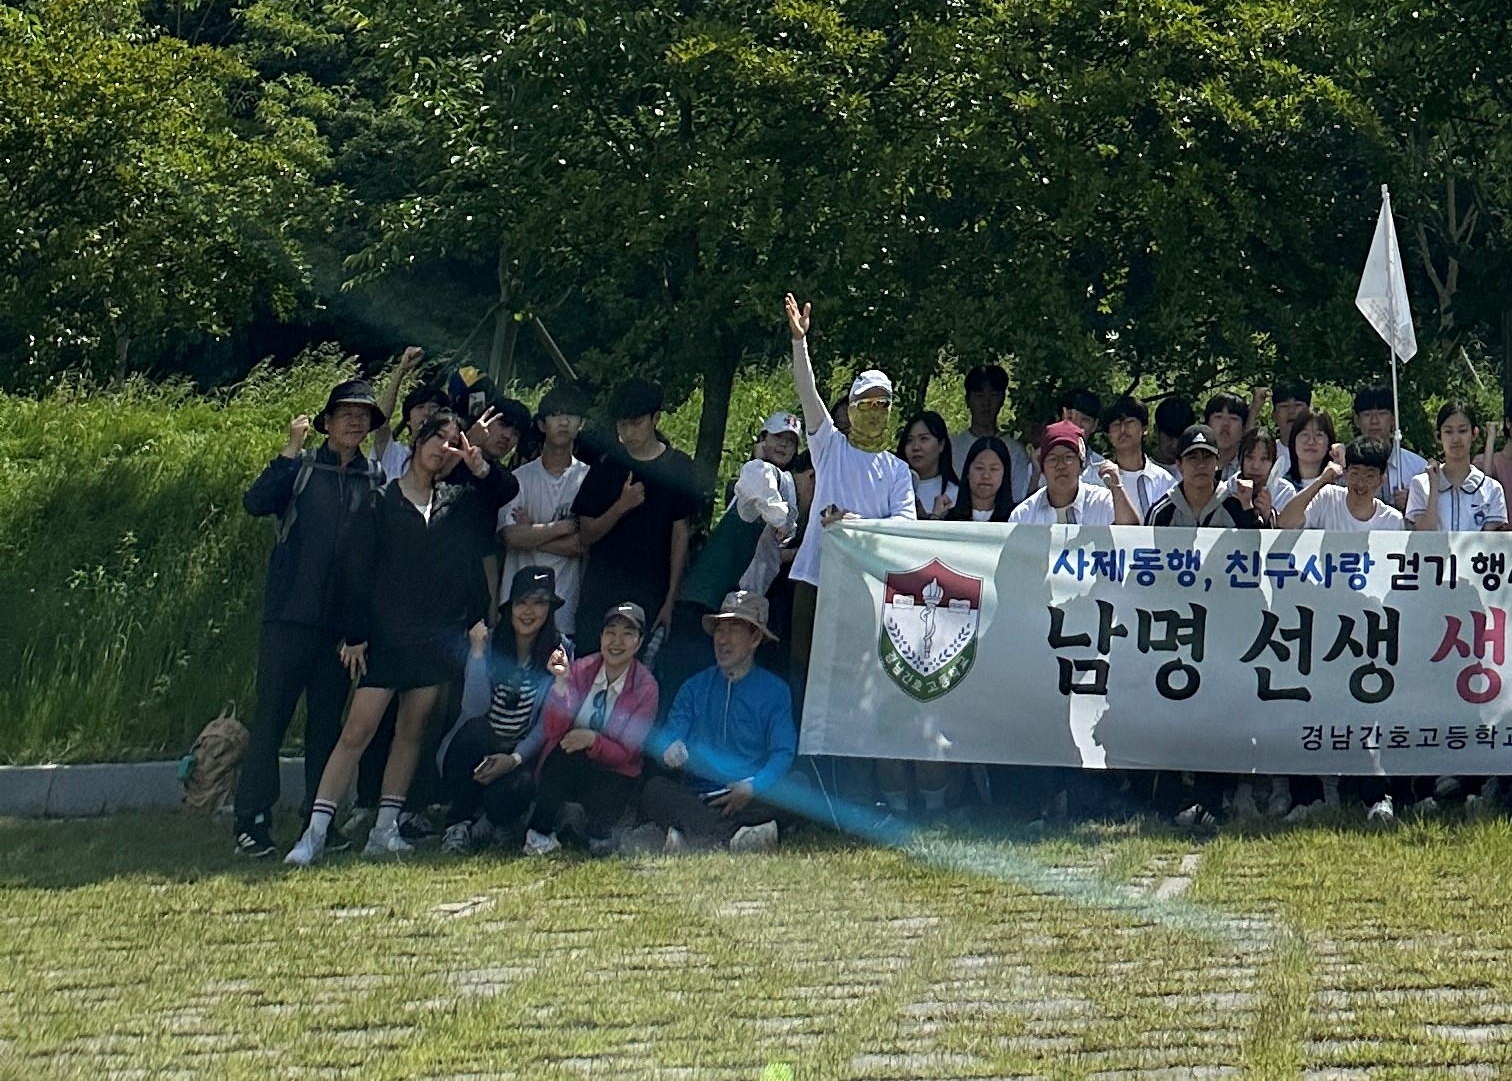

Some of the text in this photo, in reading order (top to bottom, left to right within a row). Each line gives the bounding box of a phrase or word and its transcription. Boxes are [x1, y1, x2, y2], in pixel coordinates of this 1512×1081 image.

[1052, 549, 1213, 593] 사제동행,
[1225, 550, 1376, 592] 친구사랑
[1386, 552, 1457, 591] 걷기
[1047, 600, 1208, 701] 남명
[1239, 604, 1401, 704] 선생
